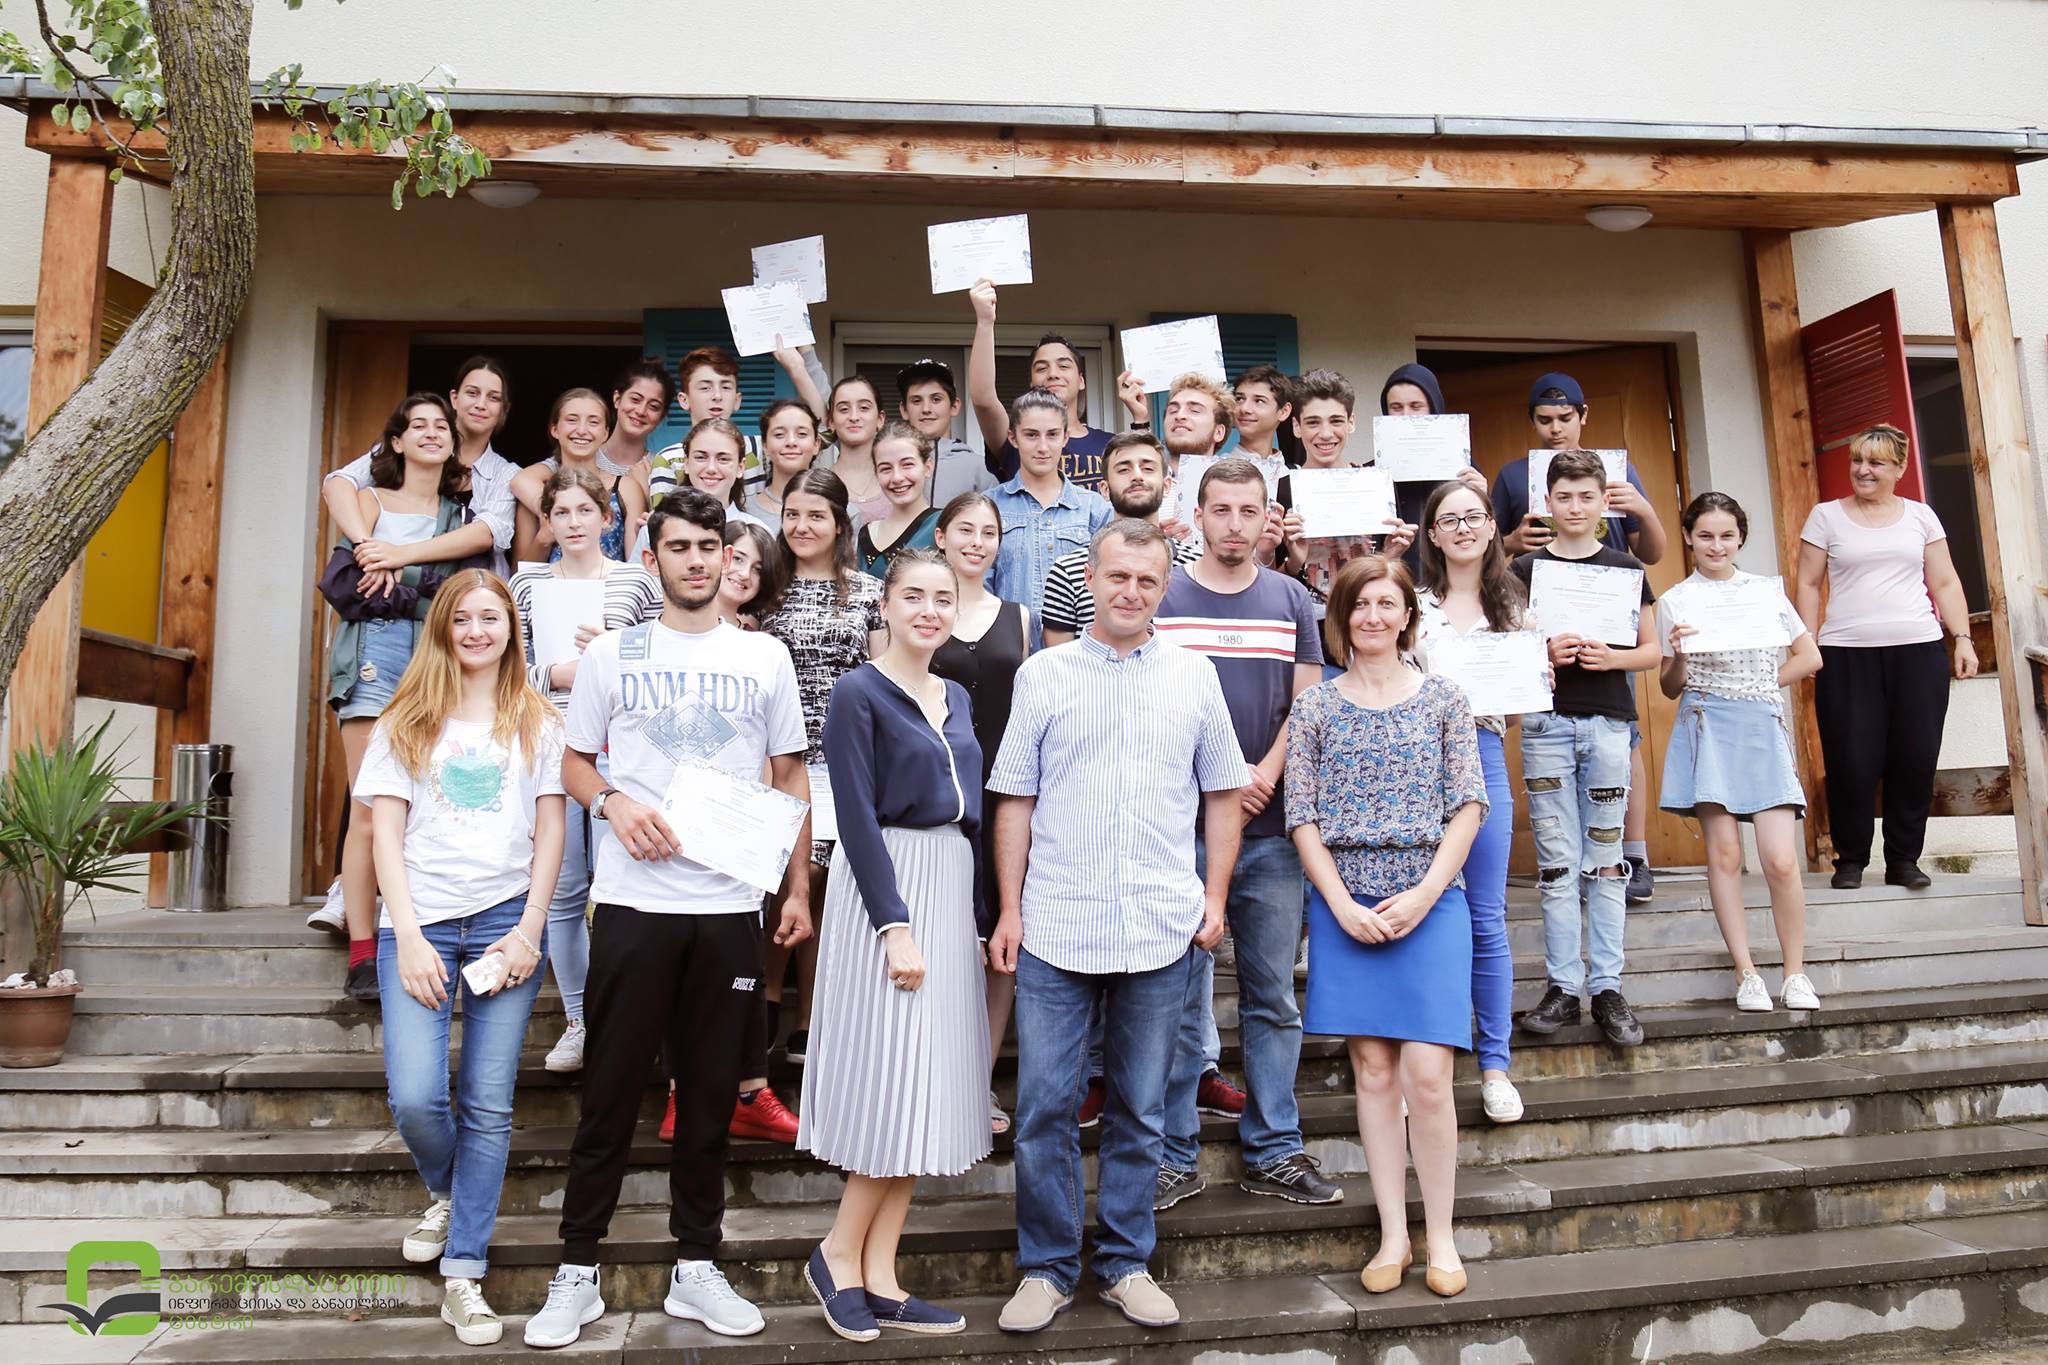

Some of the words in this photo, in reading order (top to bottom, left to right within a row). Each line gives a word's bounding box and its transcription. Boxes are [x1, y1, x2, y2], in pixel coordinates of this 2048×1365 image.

[1217, 634, 1243, 645] 1980
[620, 671, 687, 712] DNM
[698, 672, 759, 717] HDR
